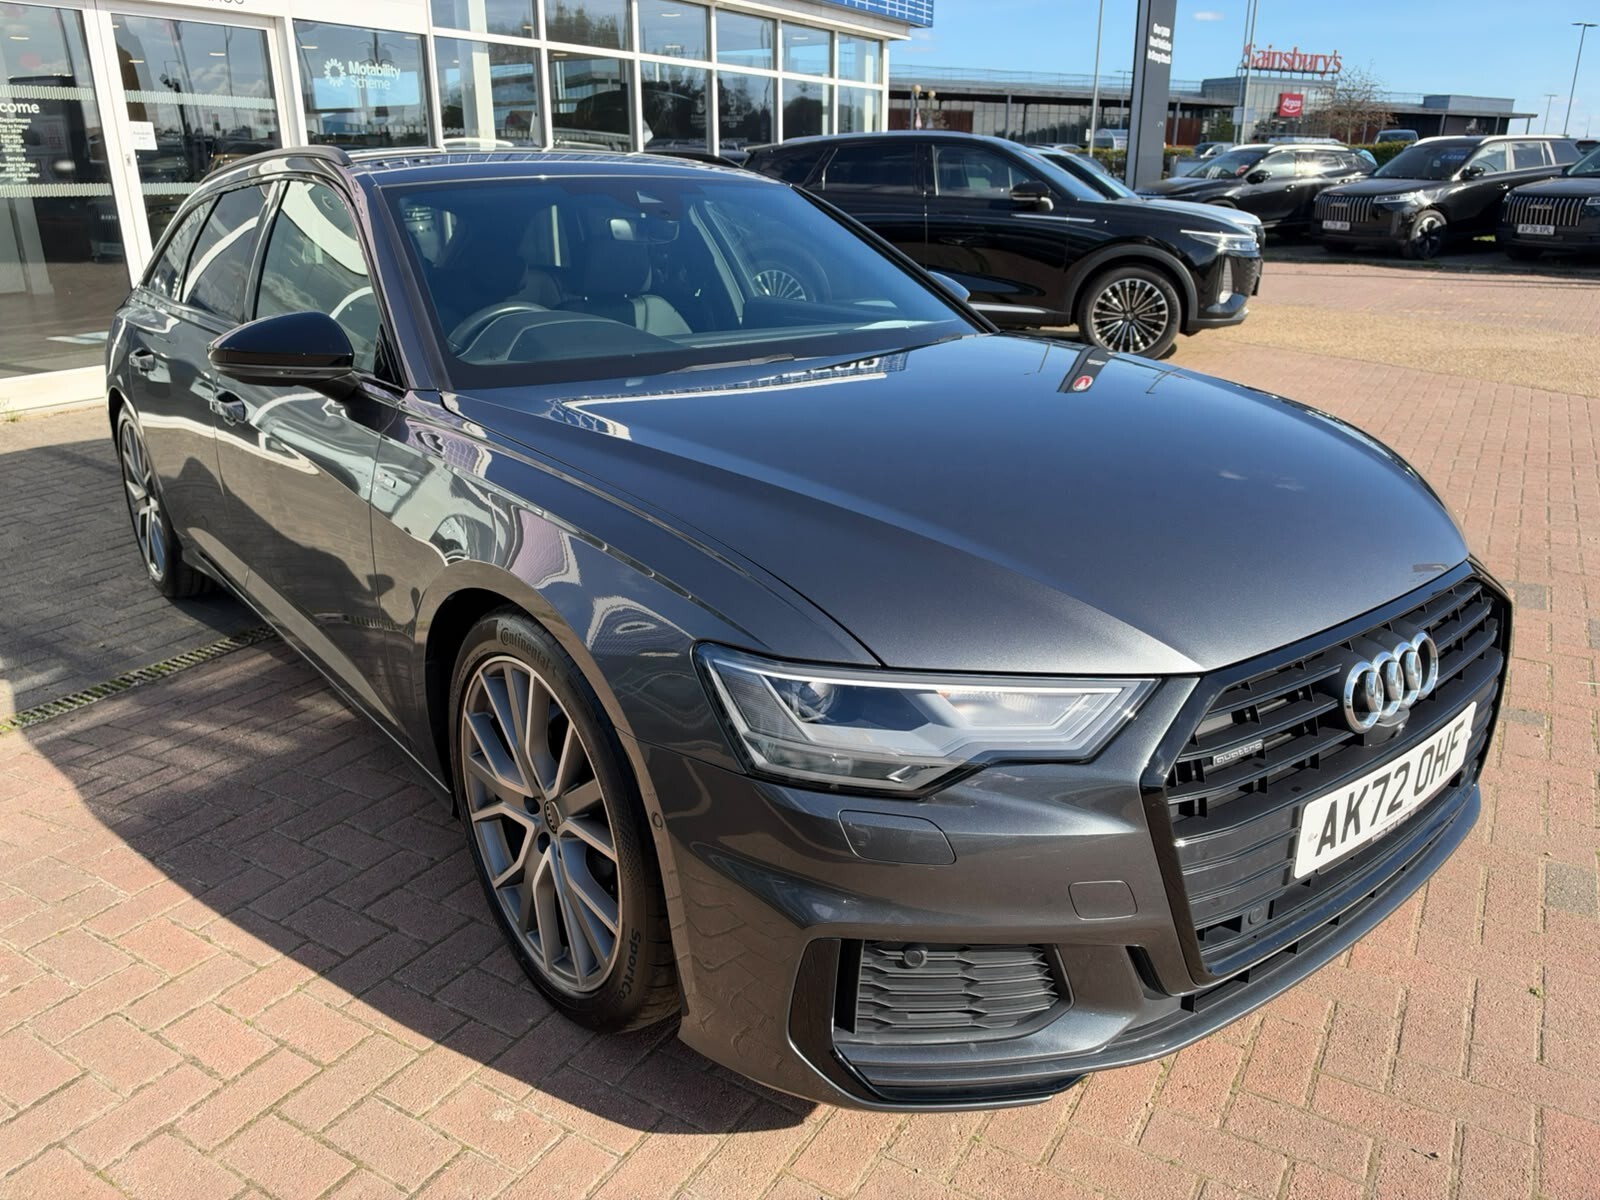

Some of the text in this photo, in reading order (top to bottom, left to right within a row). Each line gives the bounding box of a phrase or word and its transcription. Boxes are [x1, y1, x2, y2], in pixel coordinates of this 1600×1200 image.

[348, 60, 401, 80] Motability
[1243, 43, 1343, 77] Sainsbury's
[349, 75, 391, 90] Scheme
[1283, 97, 1301, 107] Argos
[500, 627, 551, 672] Continental
[1216, 742, 1262, 765] quattro
[1315, 719, 1466, 857] AK72 OHF
